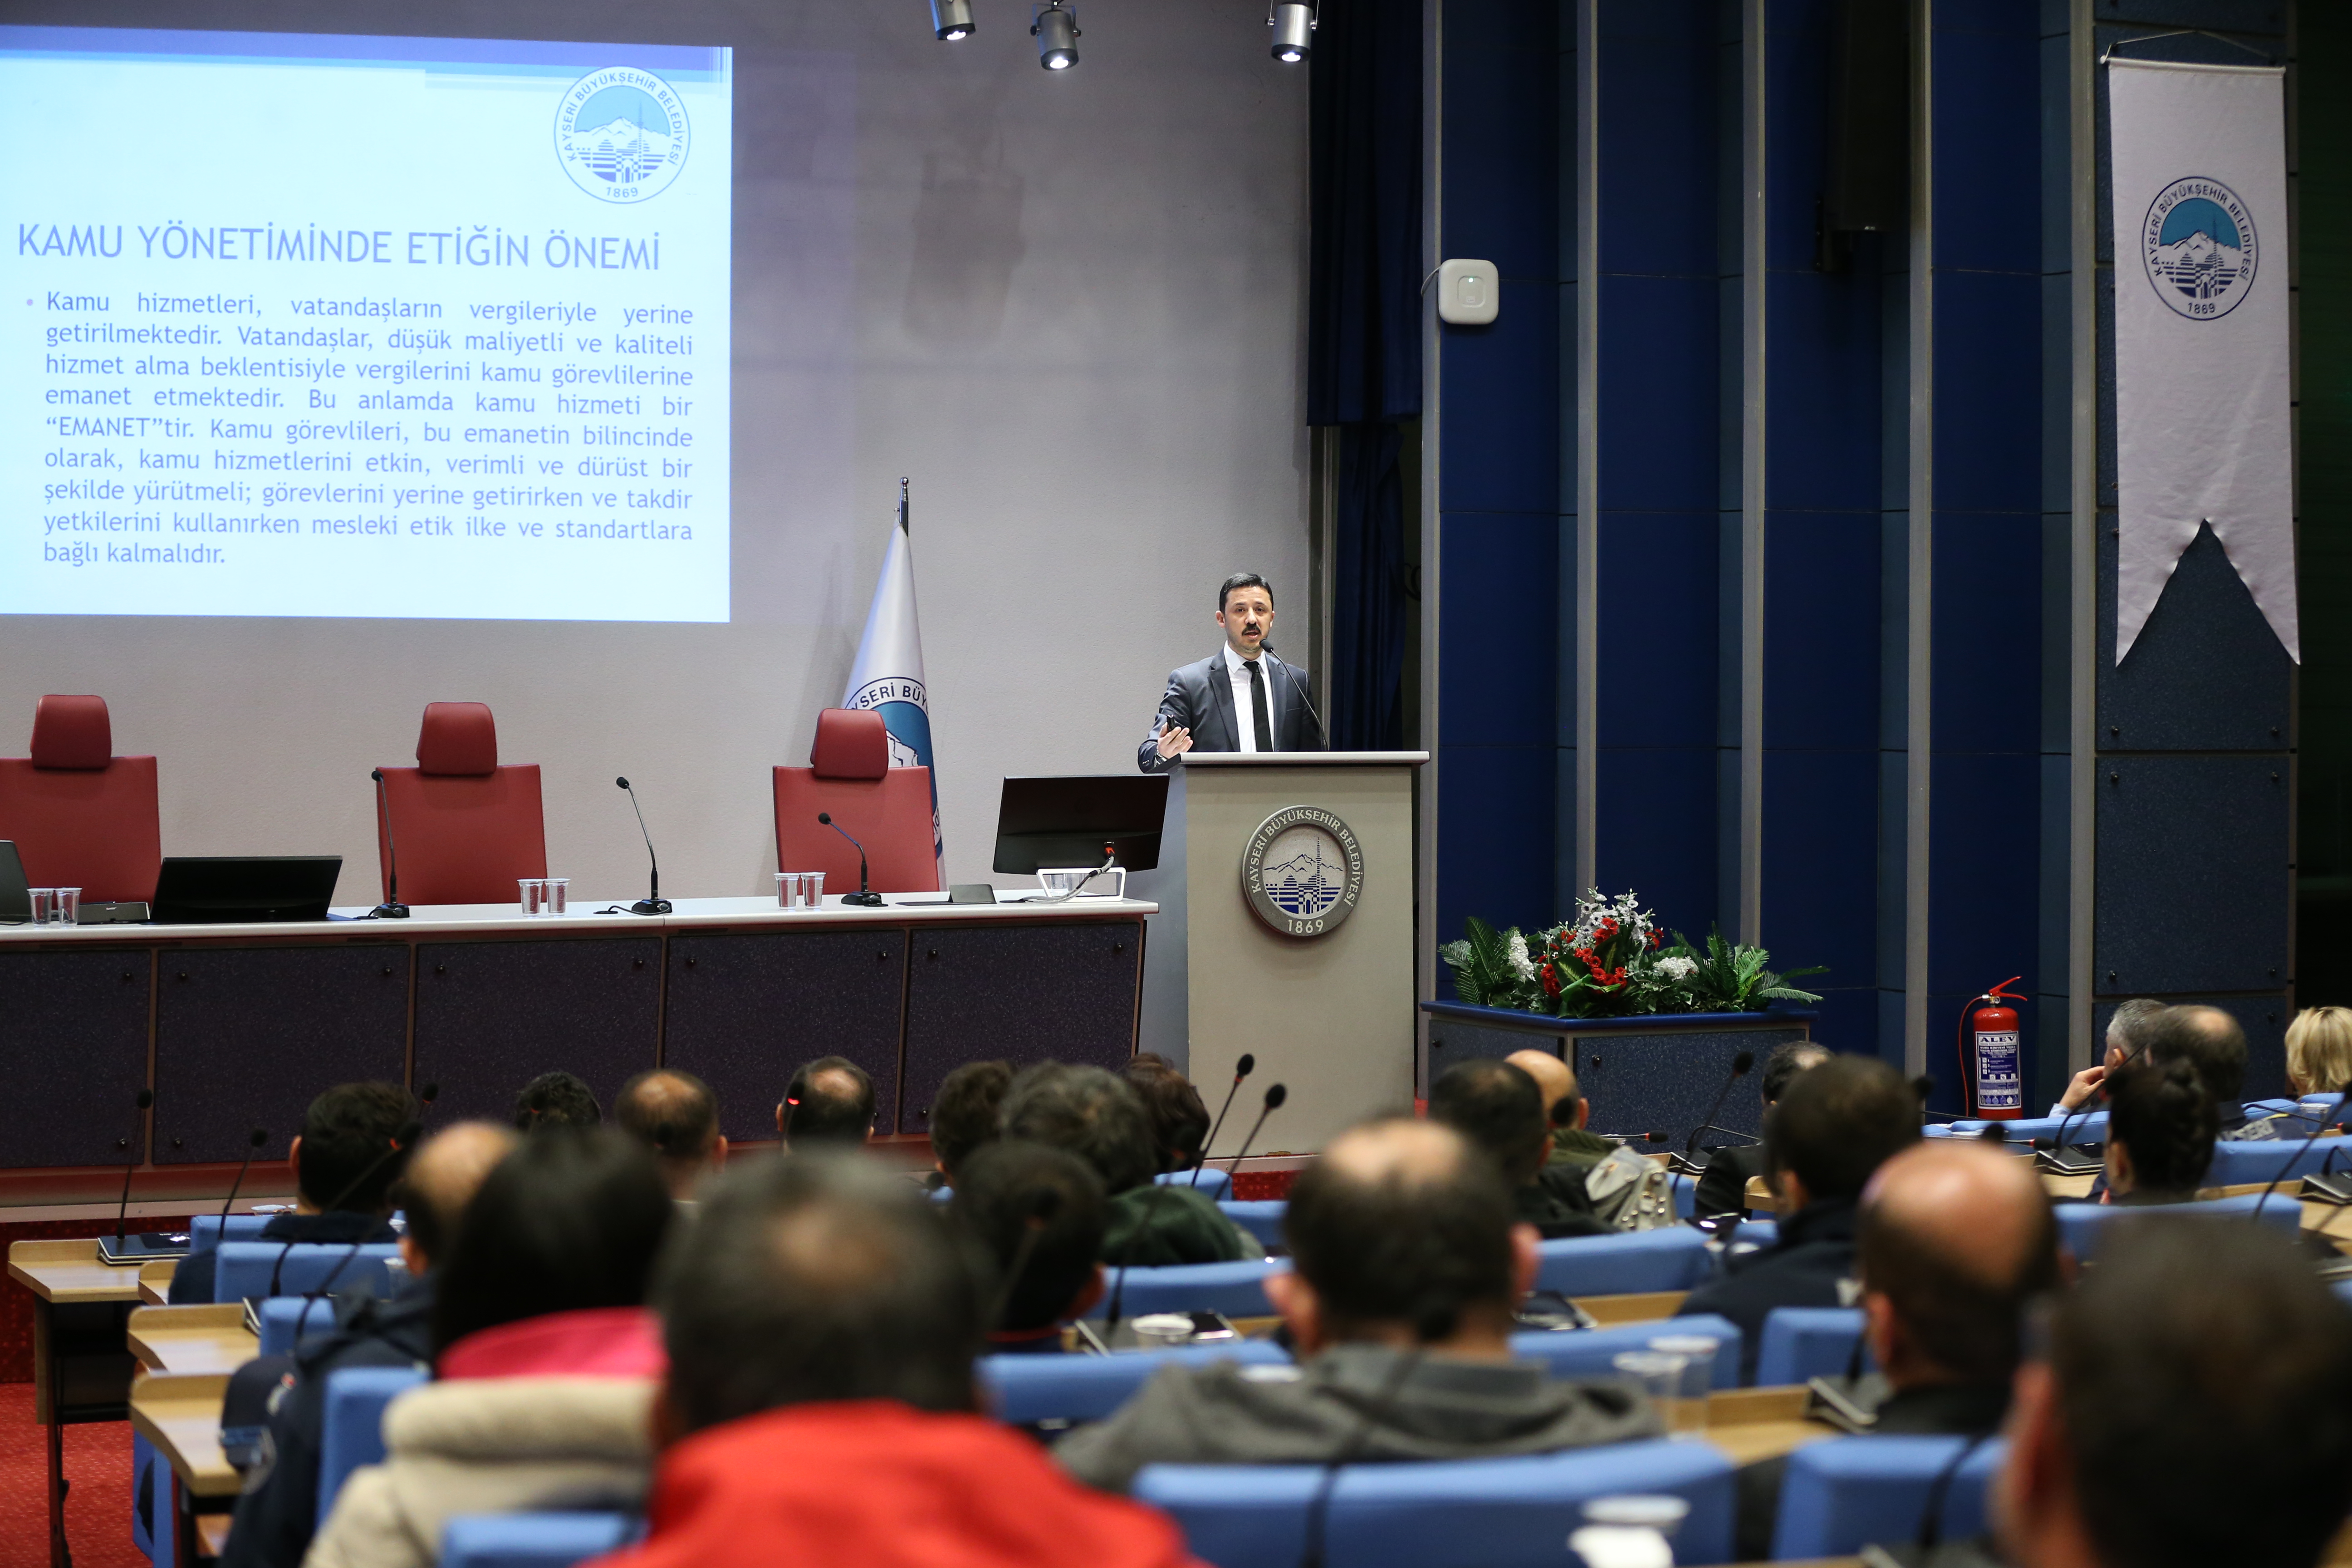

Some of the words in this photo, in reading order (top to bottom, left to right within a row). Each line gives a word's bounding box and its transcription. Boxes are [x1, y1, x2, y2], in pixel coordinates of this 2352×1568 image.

[562, 101, 578, 162] KAYSERİ
[575, 72, 657, 101] BÜYÜKŞEHİR
[657, 90, 686, 166] BELEDİYESİ
[606, 186, 638, 198] 1869
[19, 223, 122, 258] KAMU
[137, 219, 392, 263] YÖNETİMİNDE
[408, 225, 529, 267] ETİĞİN
[544, 229, 660, 270] ÖNEMİ
[2149, 212, 2163, 277] KAYSERİ
[2158, 184, 2229, 214] BÜYÜKŞEHİR
[47, 290, 109, 312] Kamu
[138, 291, 261, 318] hizmetleri,
[290, 296, 442, 323] vatandaşların
[469, 300, 597, 326] vergileriyle
[623, 304, 693, 328] yerine
[2187, 302, 2215, 314] 1869
[46, 322, 222, 348] getirilmektedir.
[237, 325, 373, 353] Vatandaşlar,
[387, 328, 452, 355] düşük
[465, 330, 563, 356] maliyetli
[576, 338, 602, 353] ve
[615, 333, 692, 355] kaliteli
[46, 353, 125, 375] hizmet
[135, 354, 190, 376] alma
[201, 355, 346, 383] beklentisiyle
[355, 359, 470, 385] vergilerini
[482, 361, 541, 382] kamu
[552, 363, 693, 388] görevlilerine
[45, 387, 132, 406] emanet
[153, 386, 284, 408] etmektedir.
[309, 388, 336, 409] Bu
[358, 389, 454, 411] anlamda
[476, 391, 535, 412] kamu
[558, 393, 640, 415] hizmeti
[663, 395, 693, 416] bir
[211, 418, 272, 439] Kamu
[286, 419, 409, 445] görevlileri,
[424, 421, 451, 442] bu
[464, 424, 569, 445] emanetin
[583, 425, 693, 447] bilincinde
[44, 446, 123, 472] olarak,
[139, 448, 200, 470] kamu
[215, 449, 351, 471] hizmetlerini
[366, 452, 430, 477] etkin,
[446, 454, 524, 475] verimli
[538, 460, 564, 475] ve
[578, 456, 649, 477] dürüst
[662, 457, 693, 478] bir
[44, 479, 125, 505] şekilde
[133, 480, 251, 505] yürütmeli;
[262, 481, 384, 507] görevlerini
[393, 484, 464, 509] yerine
[473, 485, 583, 510] getirirken
[592, 492, 617, 508] ve
[627, 488, 693, 509] takdir
[44, 510, 161, 536] yetkilerini
[173, 511, 300, 534] kullanırken
[312, 514, 397, 535] mesleki
[410, 515, 454, 536] etik
[466, 516, 506, 537] ilke
[518, 522, 544, 537] ve
[556, 519, 692, 540] standartlara
[44, 540, 98, 568] bağlı
[108, 542, 225, 564] kalmalıdır.
[1250, 833, 1268, 893] KAYSERİ
[1264, 809, 1341, 837] BÜYÜKŞEHİR
[1339, 828, 1363, 907] BELEDİYESİ
[1288, 919, 1324, 934] 1869
